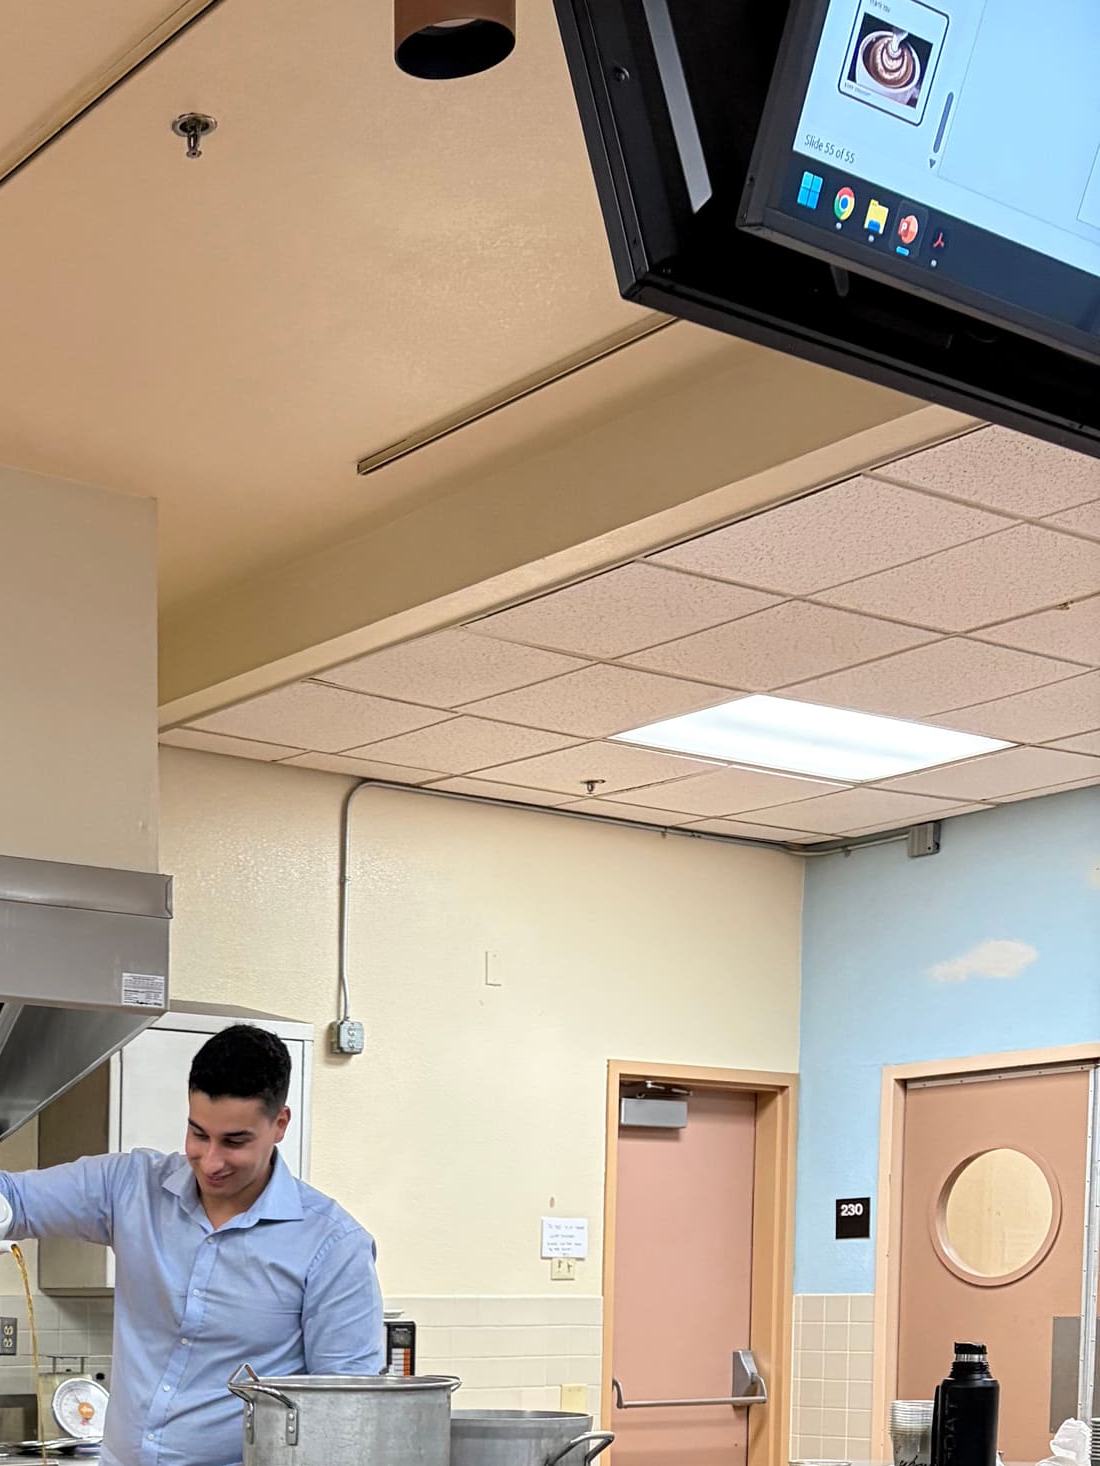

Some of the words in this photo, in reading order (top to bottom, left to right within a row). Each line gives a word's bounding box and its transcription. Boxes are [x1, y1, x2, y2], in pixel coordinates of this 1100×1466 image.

[804, 134, 824, 152] Slide
[824, 142, 835, 156] 55
[835, 147, 845, 160] of
[845, 151, 856, 164] 55
[840, 1203, 863, 1217] 230
